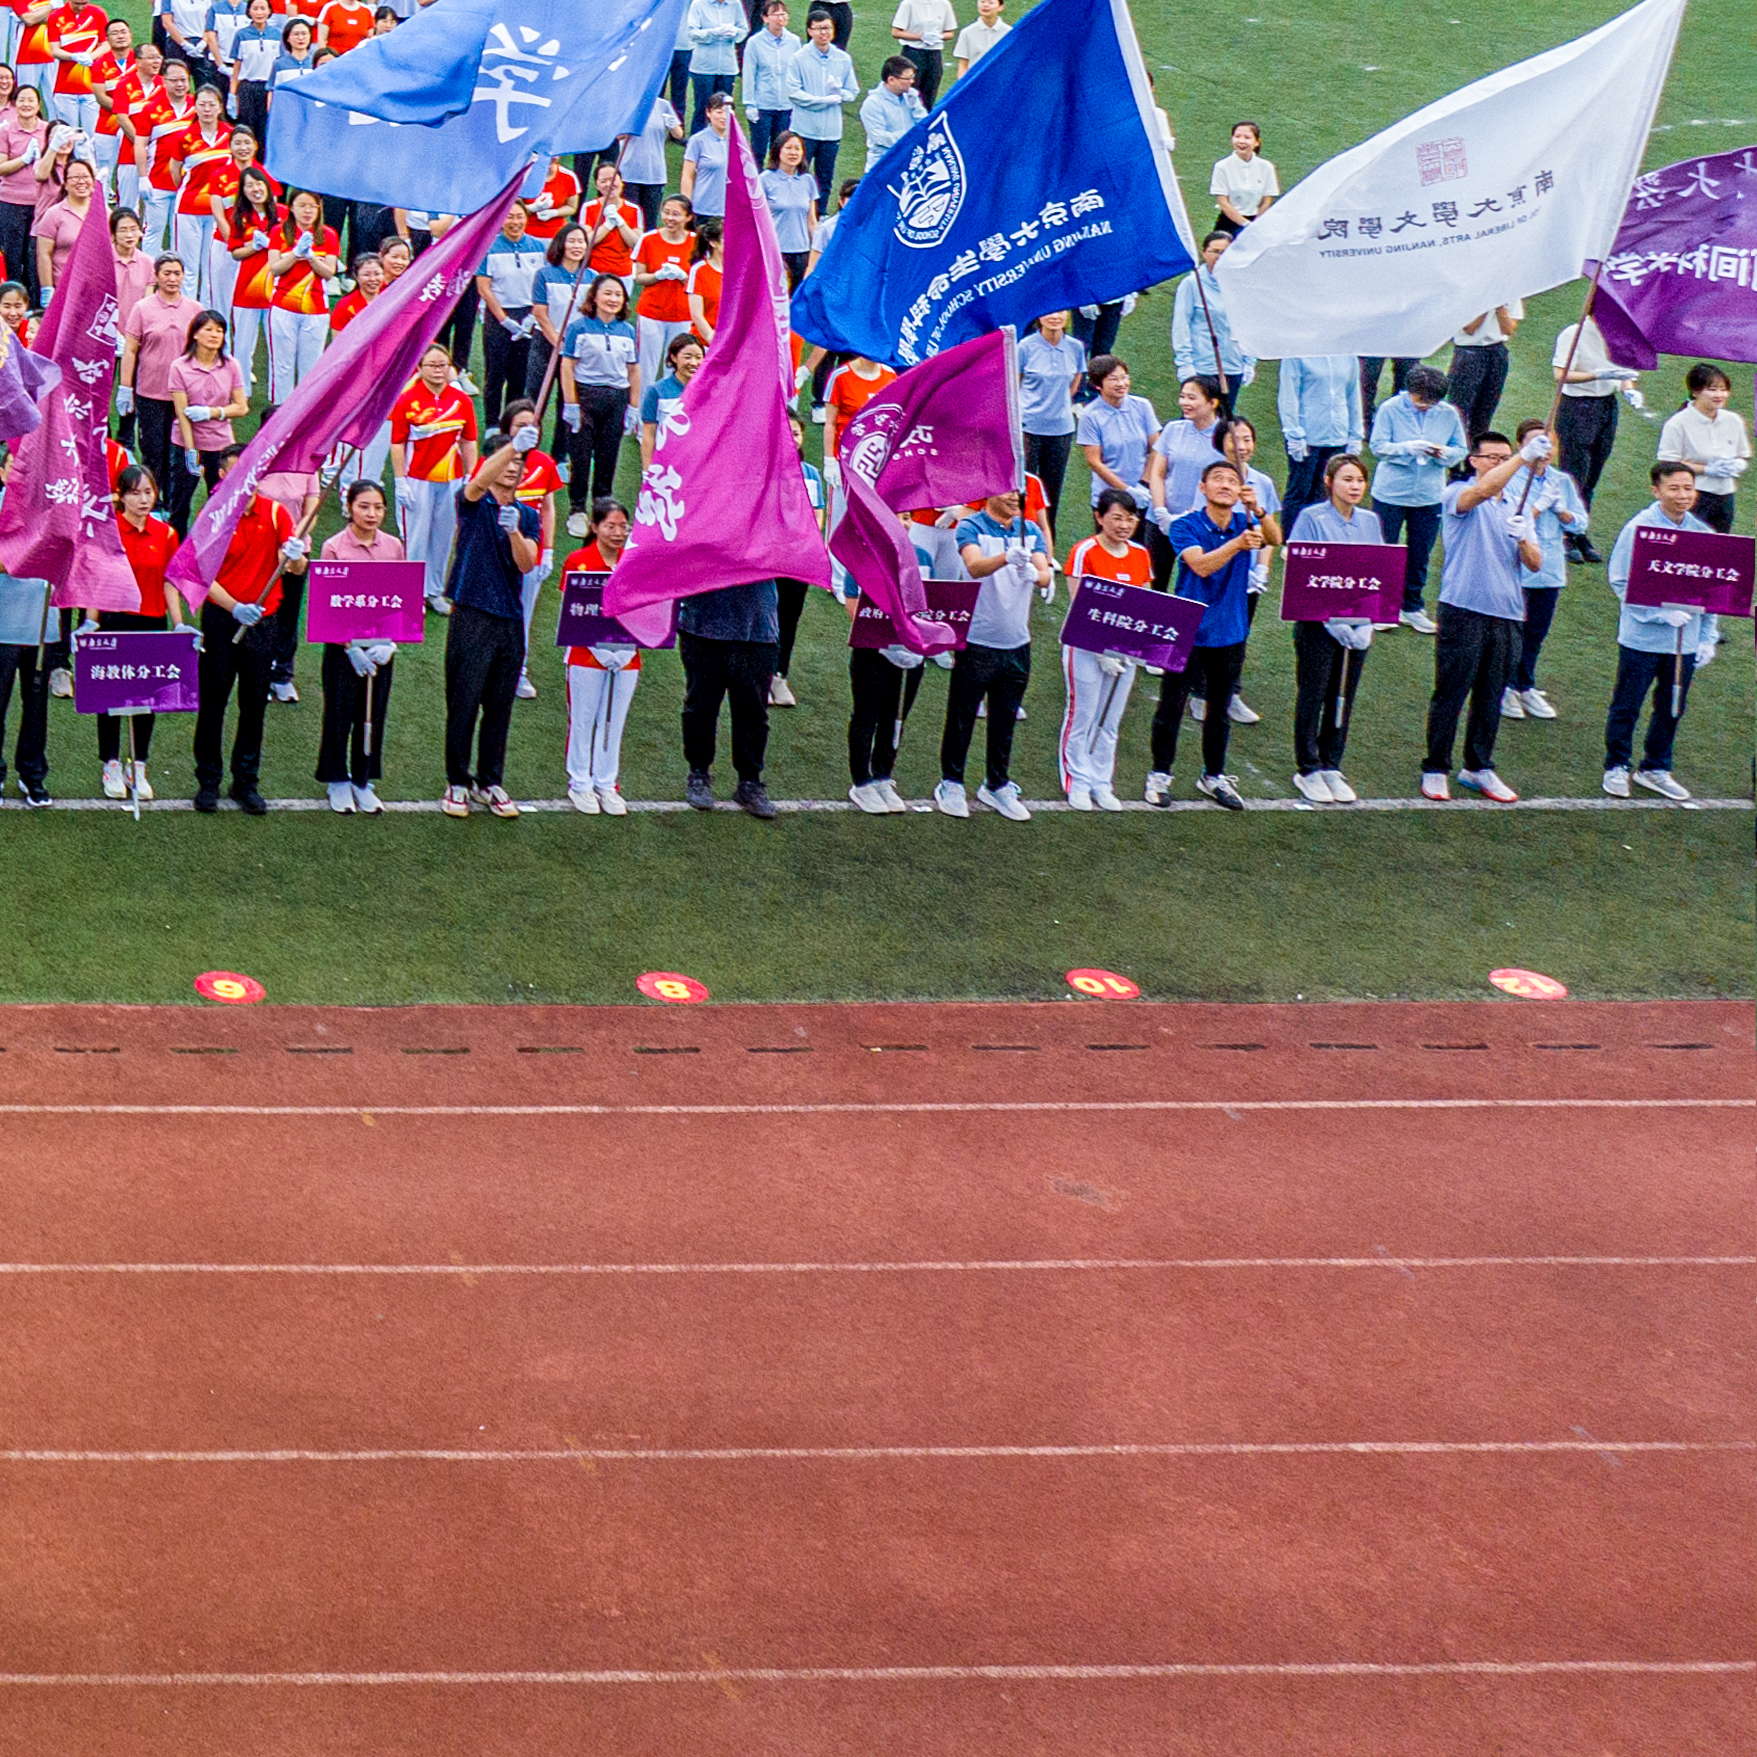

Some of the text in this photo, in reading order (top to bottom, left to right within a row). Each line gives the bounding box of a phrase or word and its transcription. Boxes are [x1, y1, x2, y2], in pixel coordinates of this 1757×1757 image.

[654, 980, 692, 1000] 8
[1073, 977, 1133, 995] 10
[1491, 977, 1558, 996] 12
